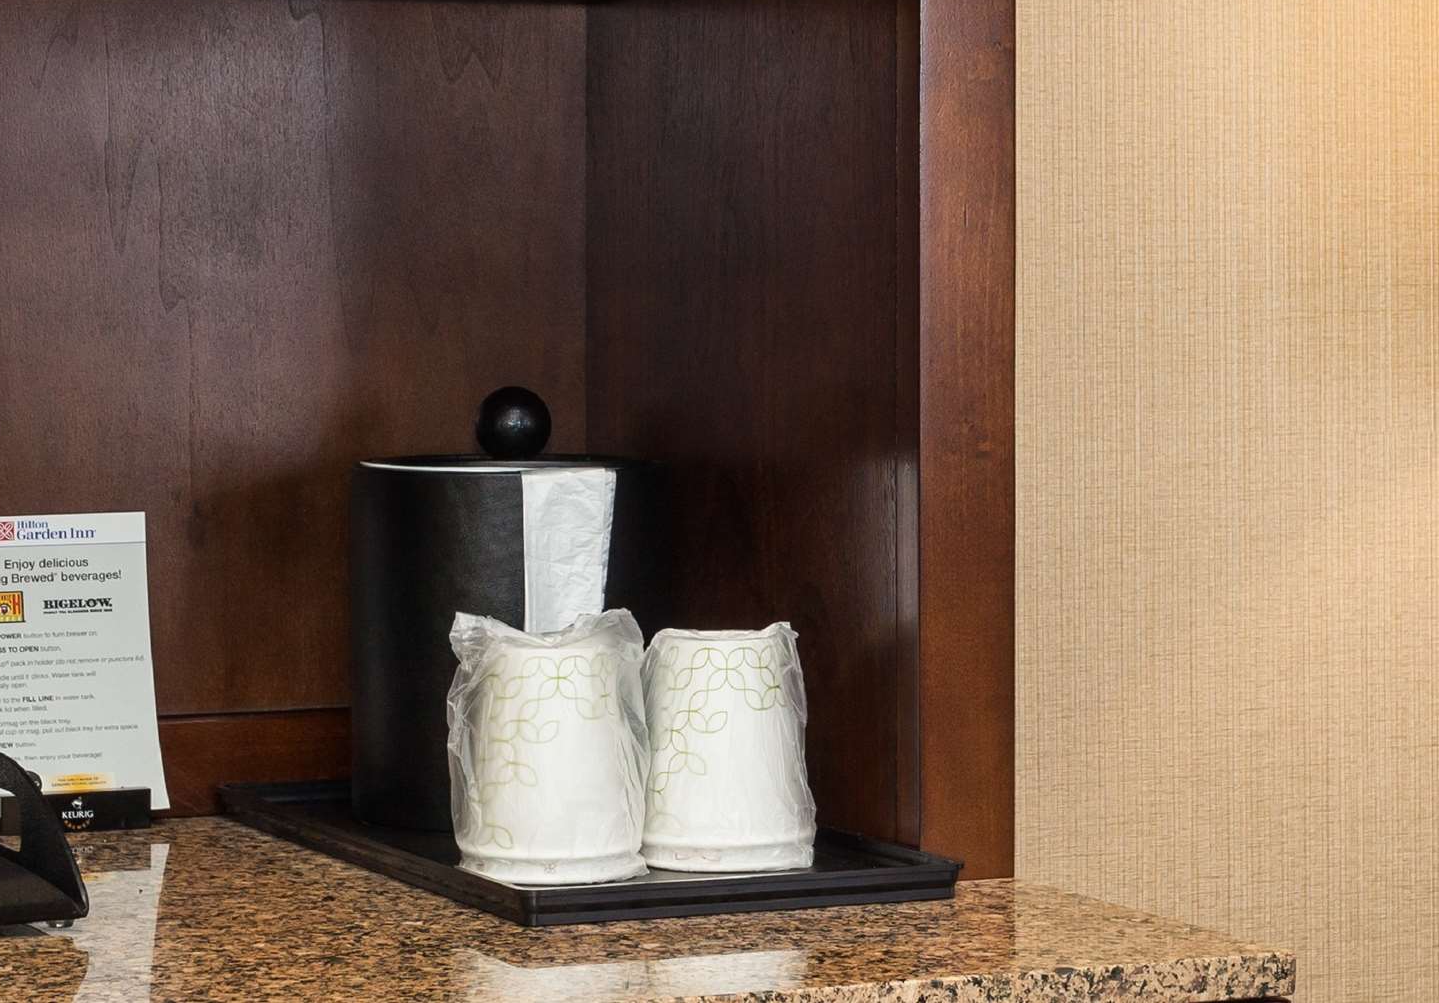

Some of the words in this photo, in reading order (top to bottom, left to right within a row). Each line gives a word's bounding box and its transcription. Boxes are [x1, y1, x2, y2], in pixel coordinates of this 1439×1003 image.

[17, 521, 48, 529] Hilton
[17, 529, 67, 540] Garden
[70, 528, 95, 539] Inn
[4, 559, 35, 571] Enjoy
[39, 558, 89, 568] delicious
[61, 570, 122, 583] beverages!
[19, 645, 39, 653] OPEN
[61, 810, 94, 819] KEURIG
